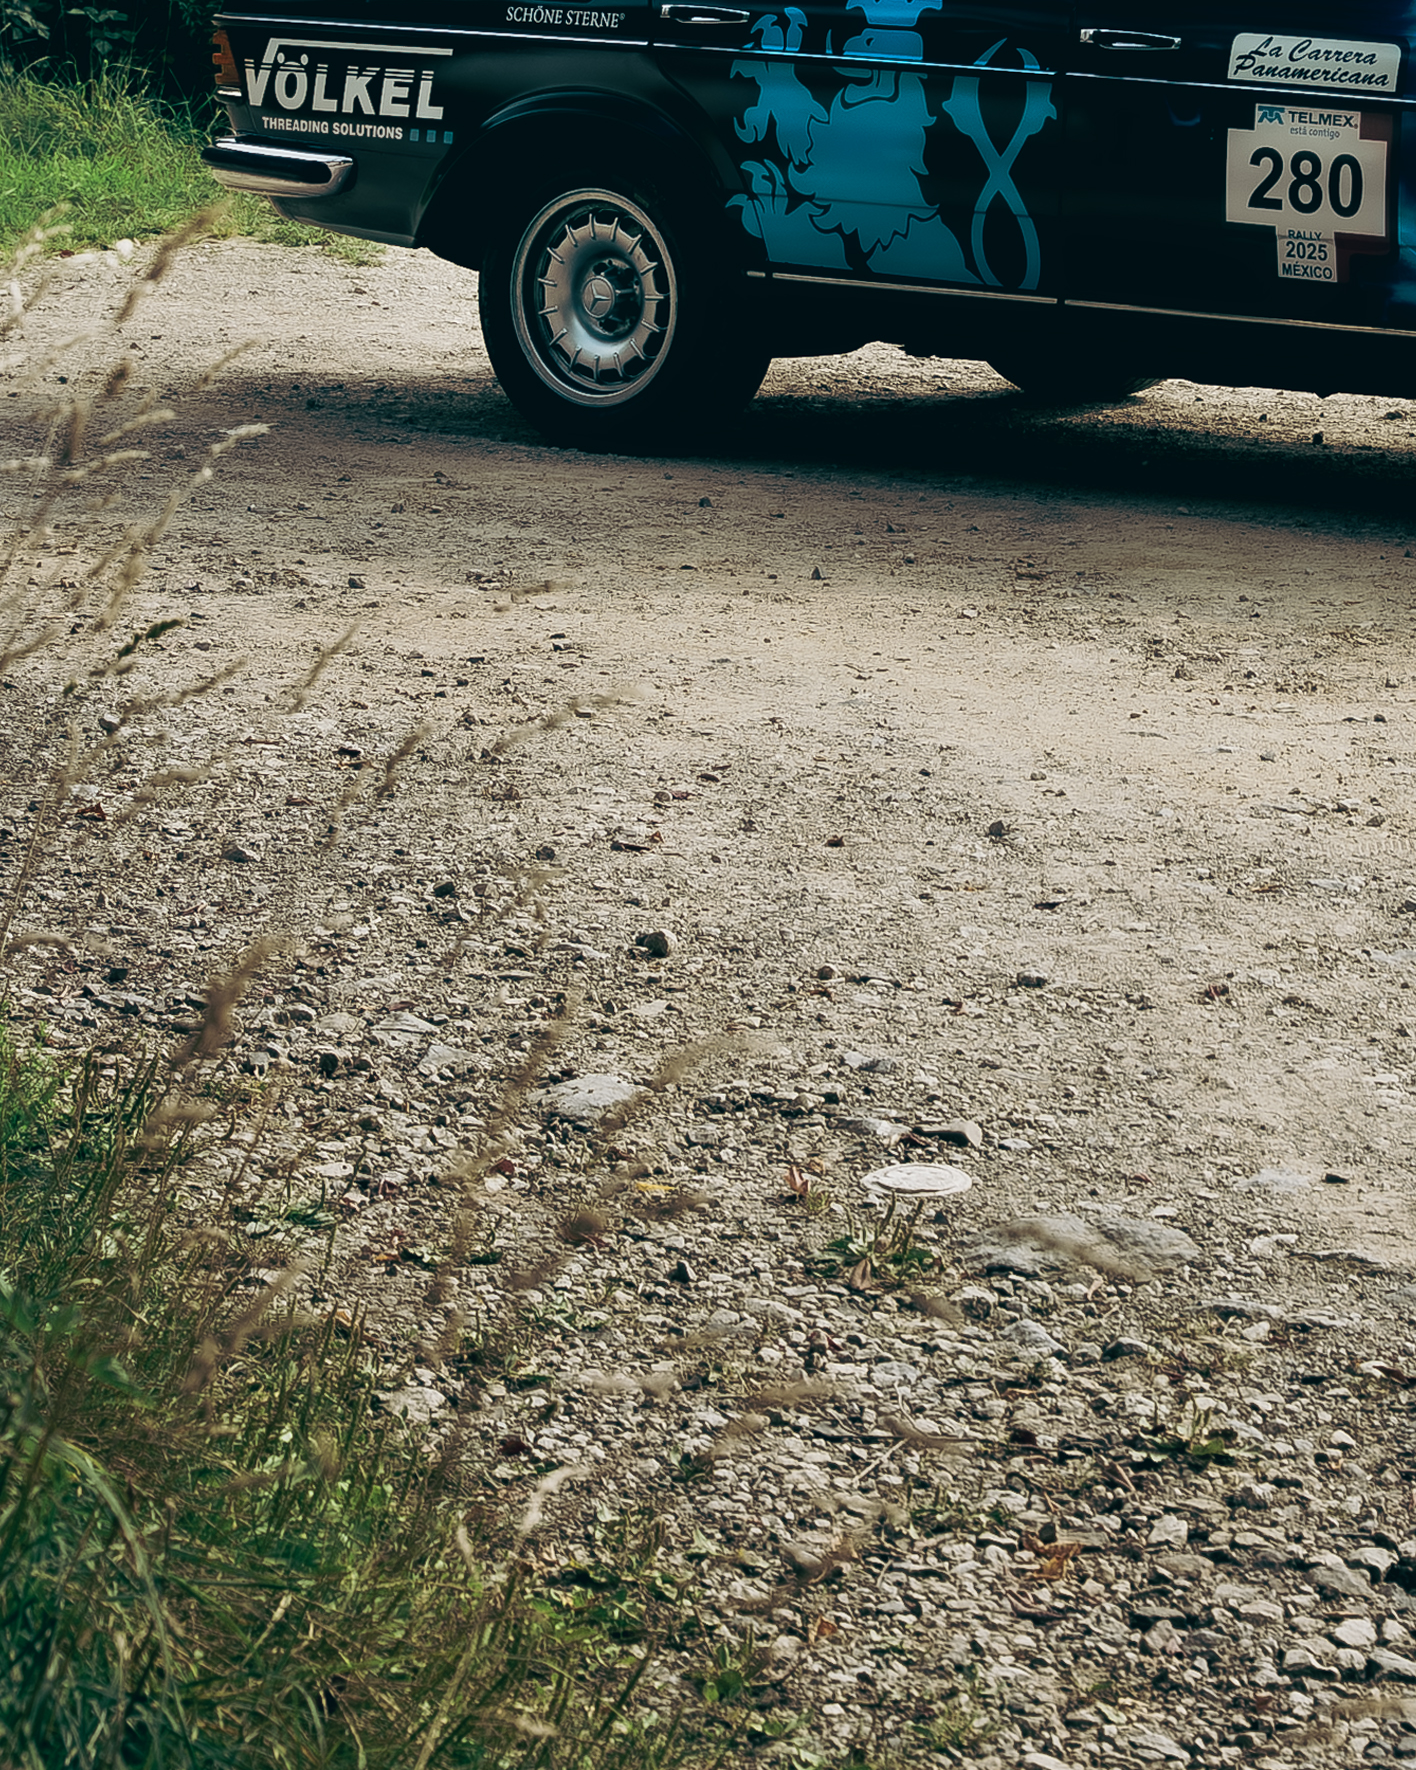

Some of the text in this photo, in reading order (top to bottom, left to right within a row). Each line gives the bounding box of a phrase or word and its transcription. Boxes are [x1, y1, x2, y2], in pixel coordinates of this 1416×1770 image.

[505, 5, 563, 25] SCHÖNE
[1247, 36, 1378, 66] La Carrera
[1233, 54, 1390, 87] Panamericana
[244, 52, 444, 120] VÖLKEL
[262, 116, 403, 140] THREADING SOLUTIONS
[1290, 126, 1341, 141] está contigo
[1247, 146, 1364, 218] 280
[1288, 229, 1322, 241] RALLY
[1285, 240, 1328, 262] 2025
[1281, 261, 1333, 280] MÉXICO
